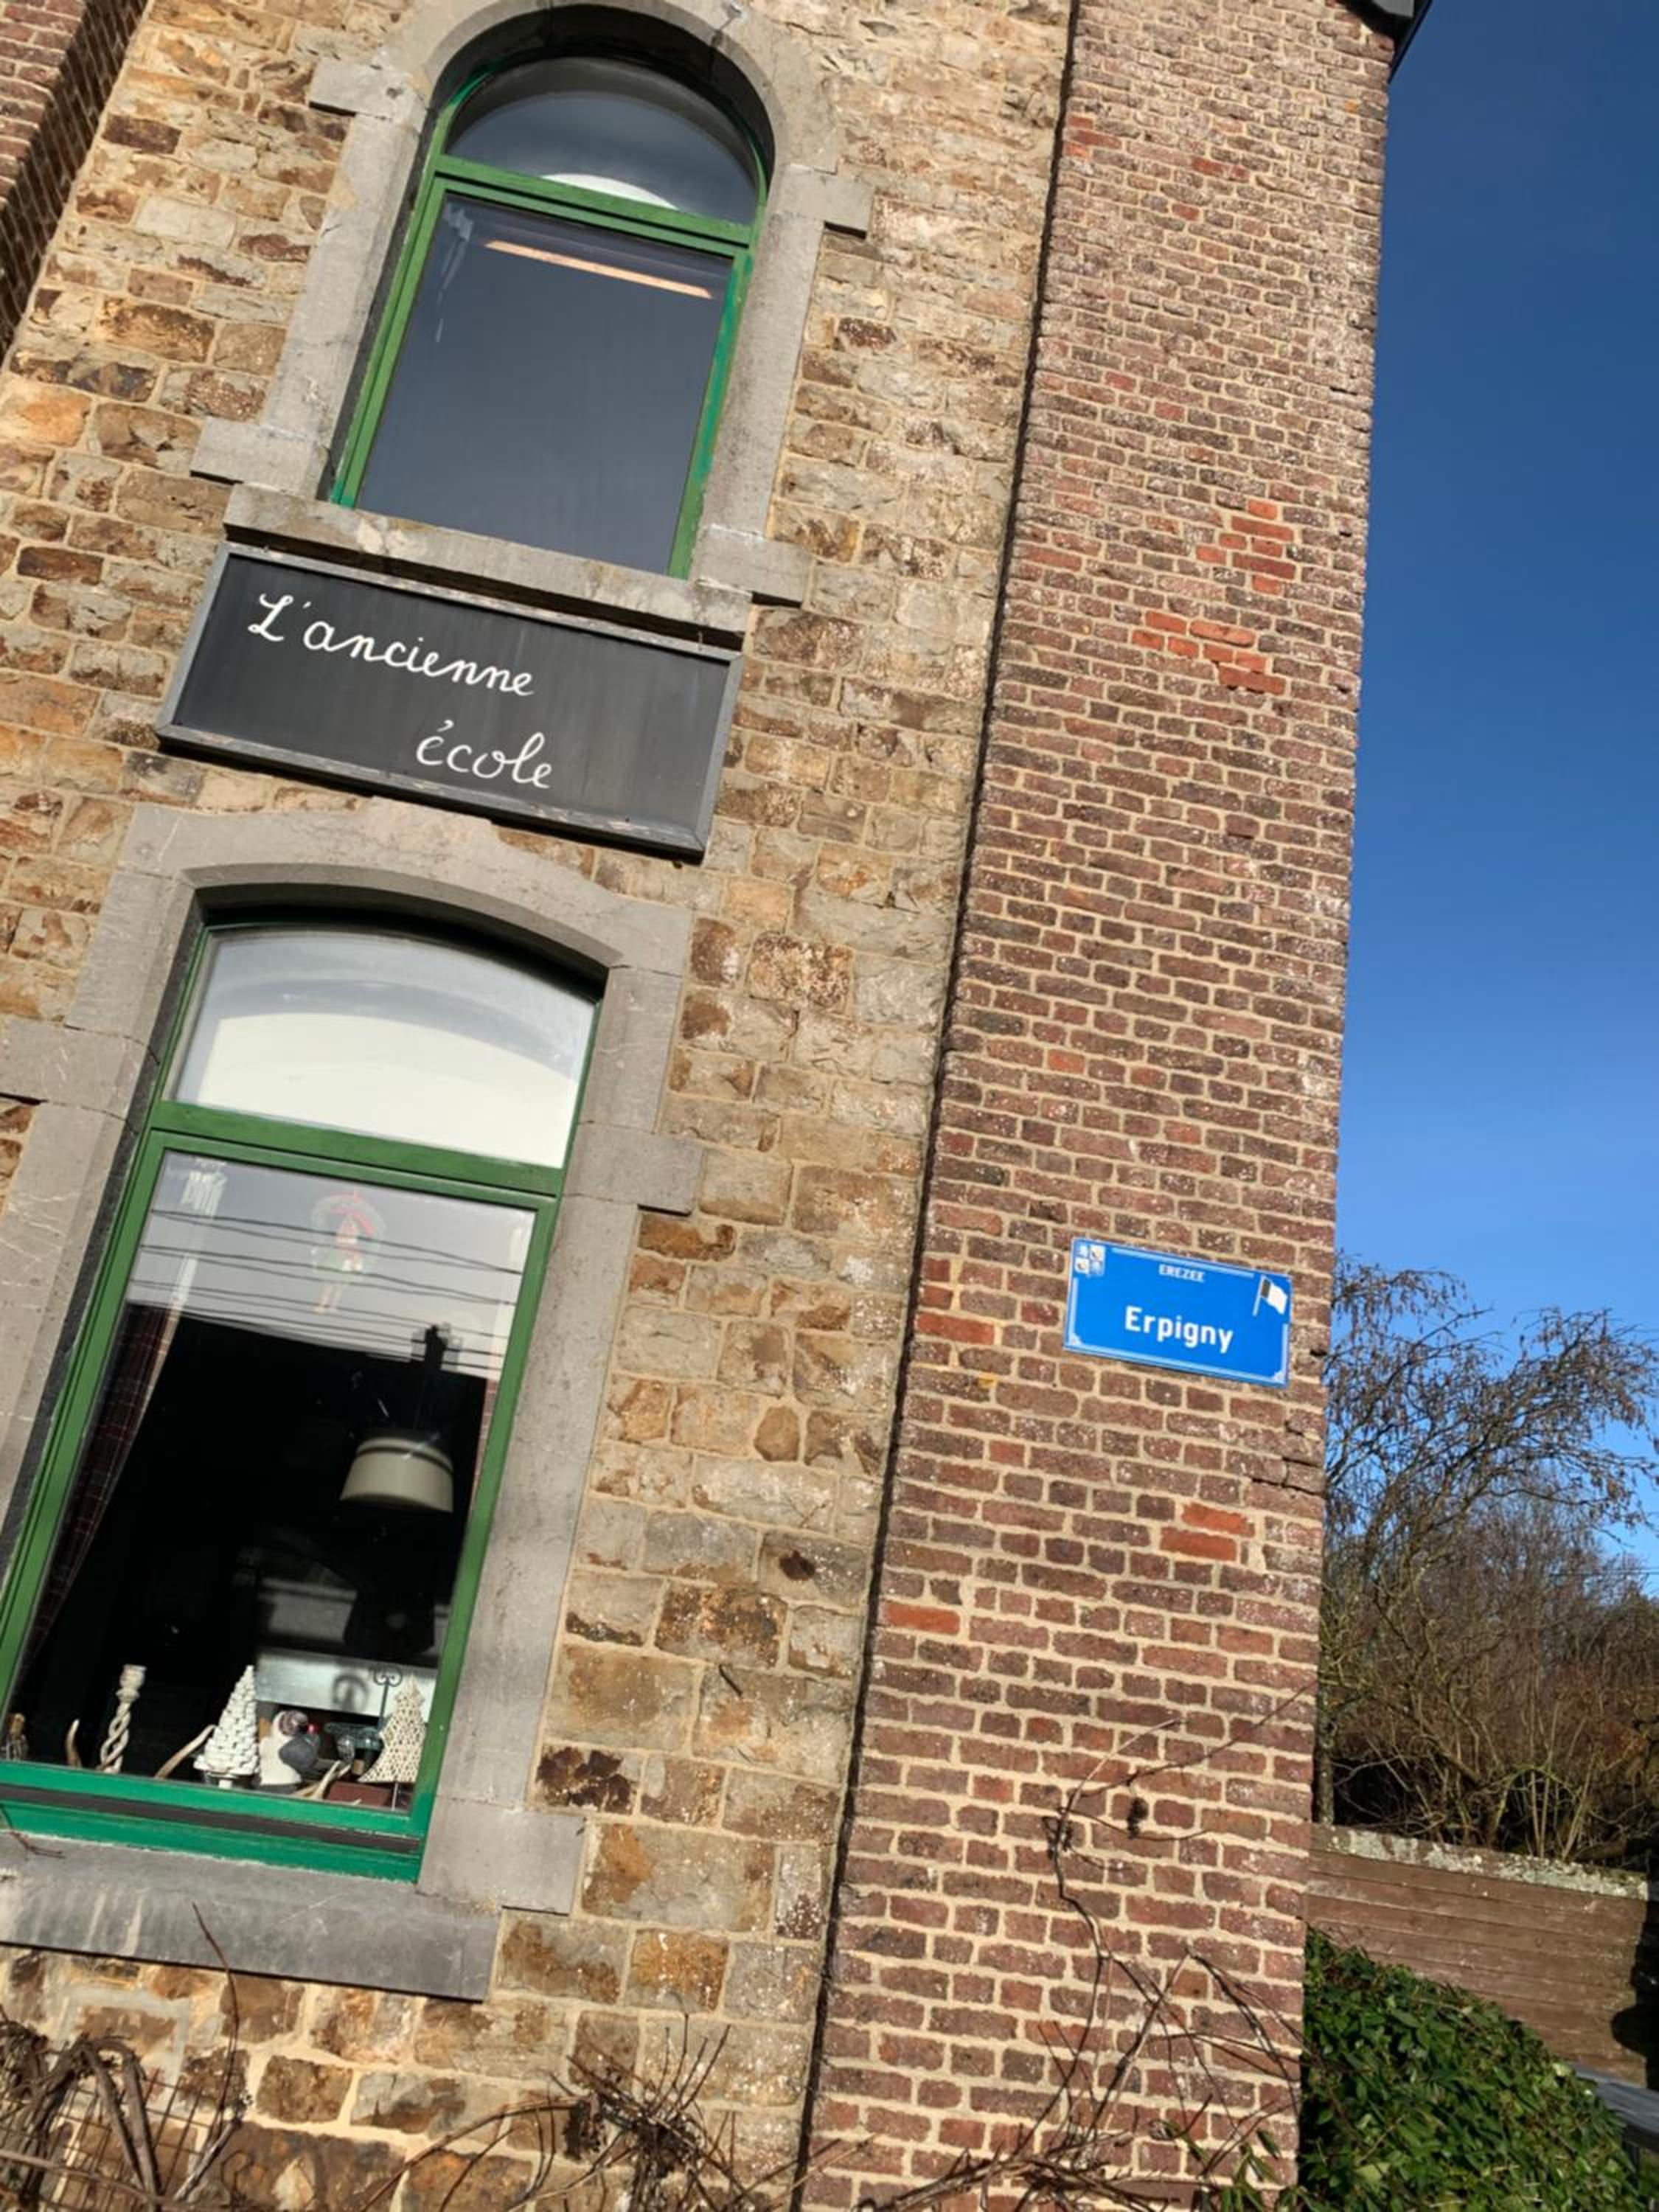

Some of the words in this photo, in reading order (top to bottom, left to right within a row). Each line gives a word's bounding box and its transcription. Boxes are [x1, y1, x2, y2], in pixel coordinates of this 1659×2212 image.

[248, 593, 535, 696] L'ancienne
[416, 720, 553, 789] école
[1124, 1305, 1234, 1354] Erpigny
